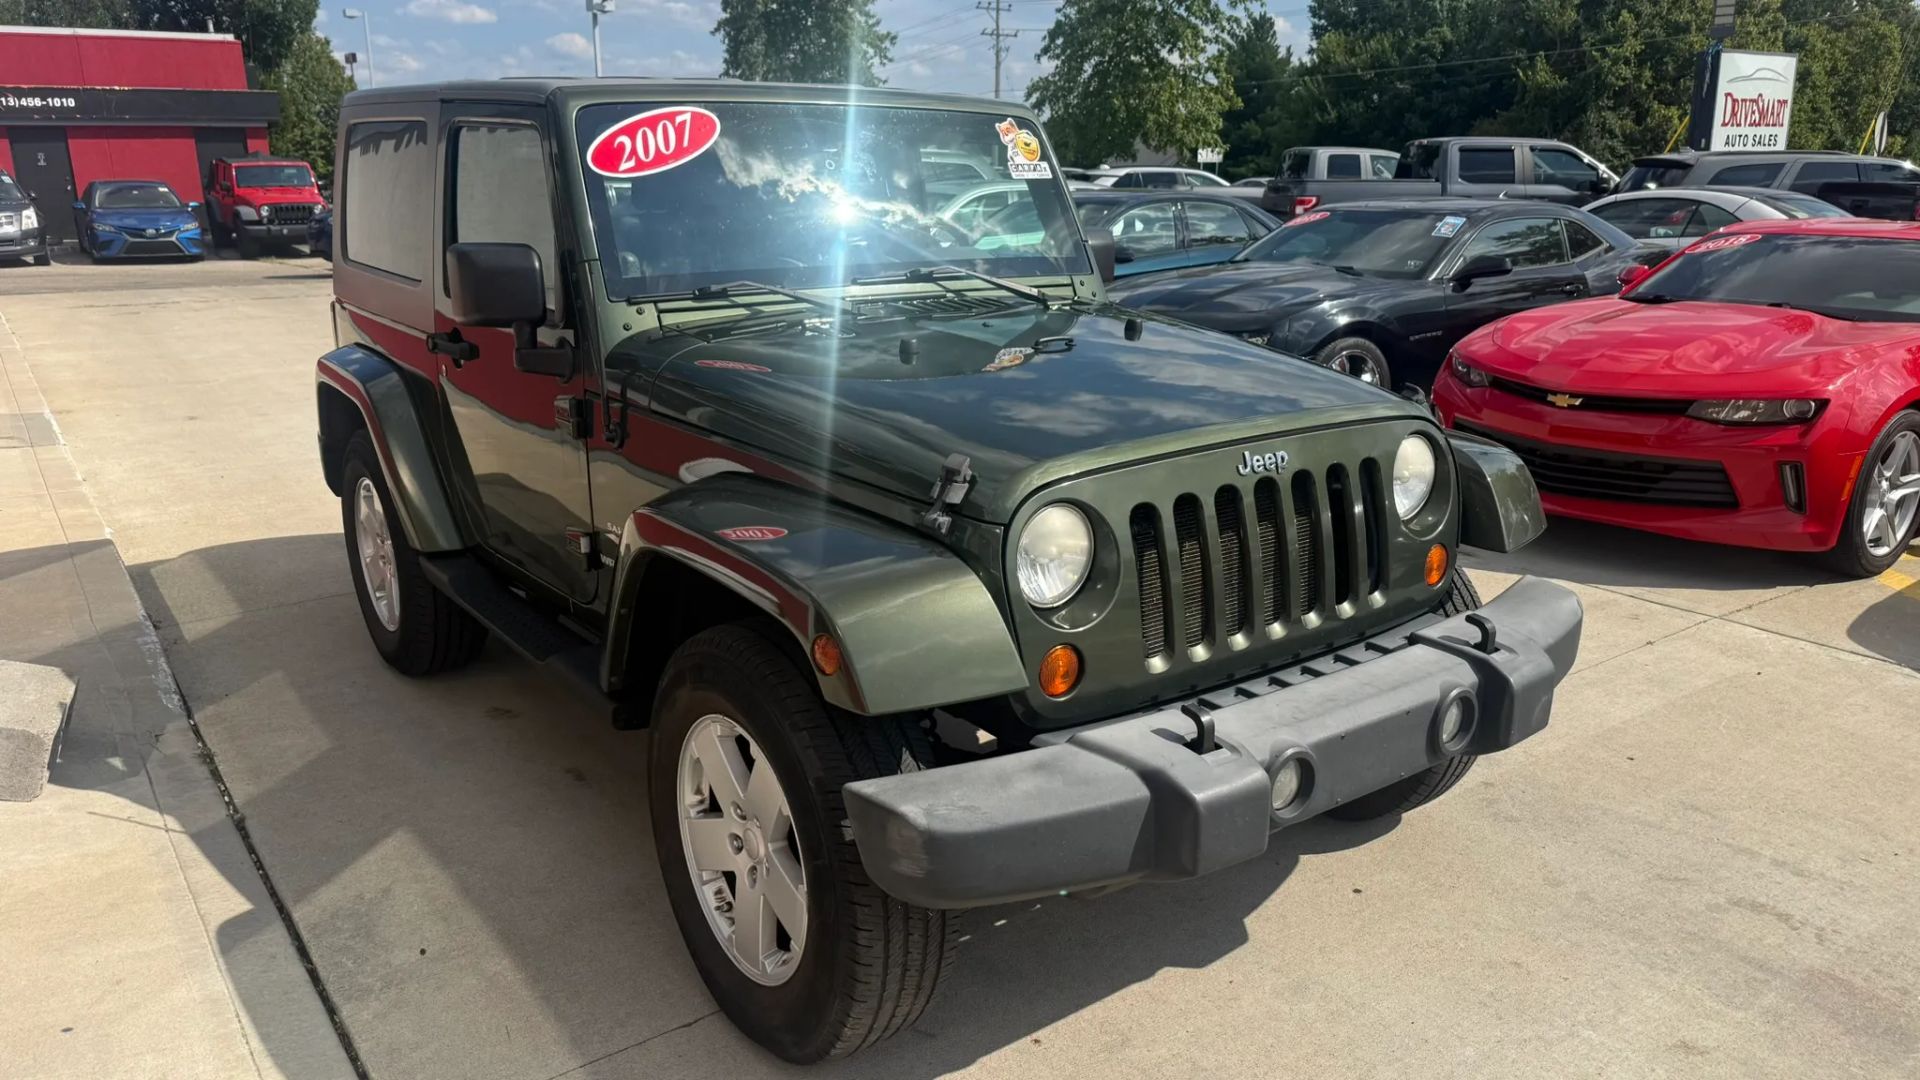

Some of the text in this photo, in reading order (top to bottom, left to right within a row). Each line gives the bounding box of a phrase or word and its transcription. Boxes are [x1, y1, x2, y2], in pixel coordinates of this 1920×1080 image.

[613, 111, 692, 172] 2007
[1723, 133, 1779, 148] AUTO SALES
[1236, 450, 1289, 477] Jeep
